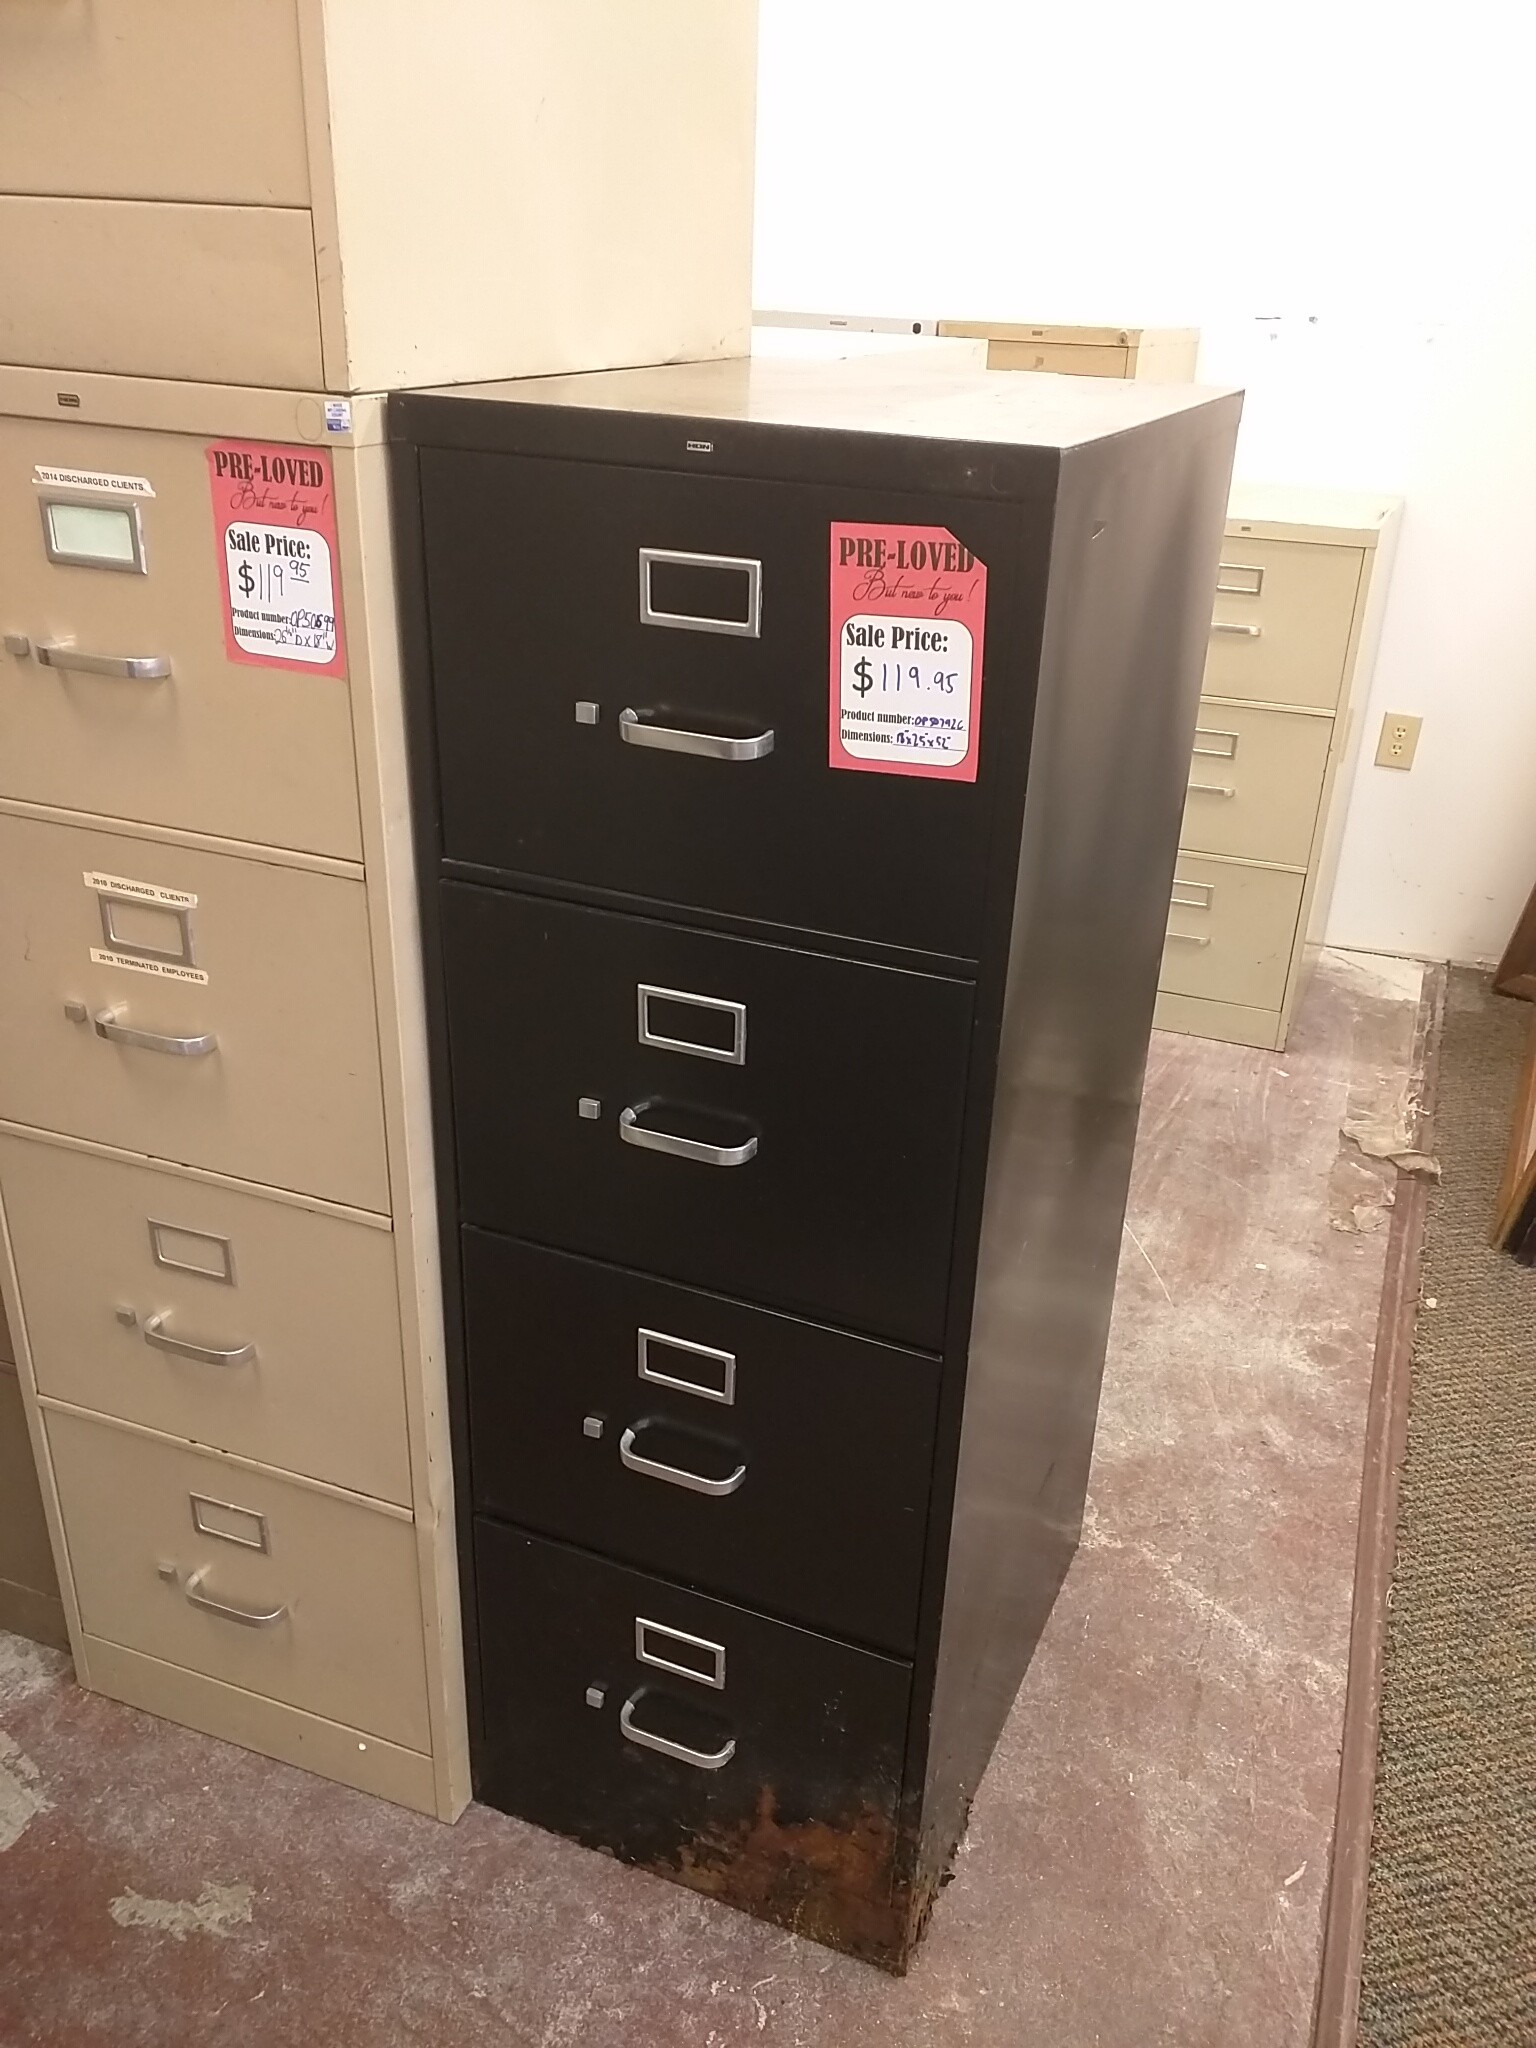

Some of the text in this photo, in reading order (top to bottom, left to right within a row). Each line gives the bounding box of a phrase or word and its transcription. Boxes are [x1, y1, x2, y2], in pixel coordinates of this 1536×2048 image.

[41, 472, 144, 491] 2014 DISCHARGED CLIENTS
[214, 451, 323, 488] PRE-LOVED
[230, 480, 278, 509] But
[288, 491, 307, 511] to
[229, 529, 311, 559] Sale Price:
[839, 537, 975, 573] PRE-LOVED
[853, 567, 914, 601] But
[923, 577, 951, 601] to
[232, 607, 260, 621] Product
[261, 613, 291, 625] number:
[234, 626, 276, 641] Dimensions:
[846, 623, 949, 652] Sale Price:
[841, 709, 875, 722] Product
[877, 713, 915, 726] number:
[841, 729, 894, 744] Dimensions:
[110, 881, 155, 897] DISCHARGED
[160, 891, 190, 903] CLIENTS
[116, 957, 159, 972] TERMINATED
[162, 966, 204, 981] EMPLOYEES
